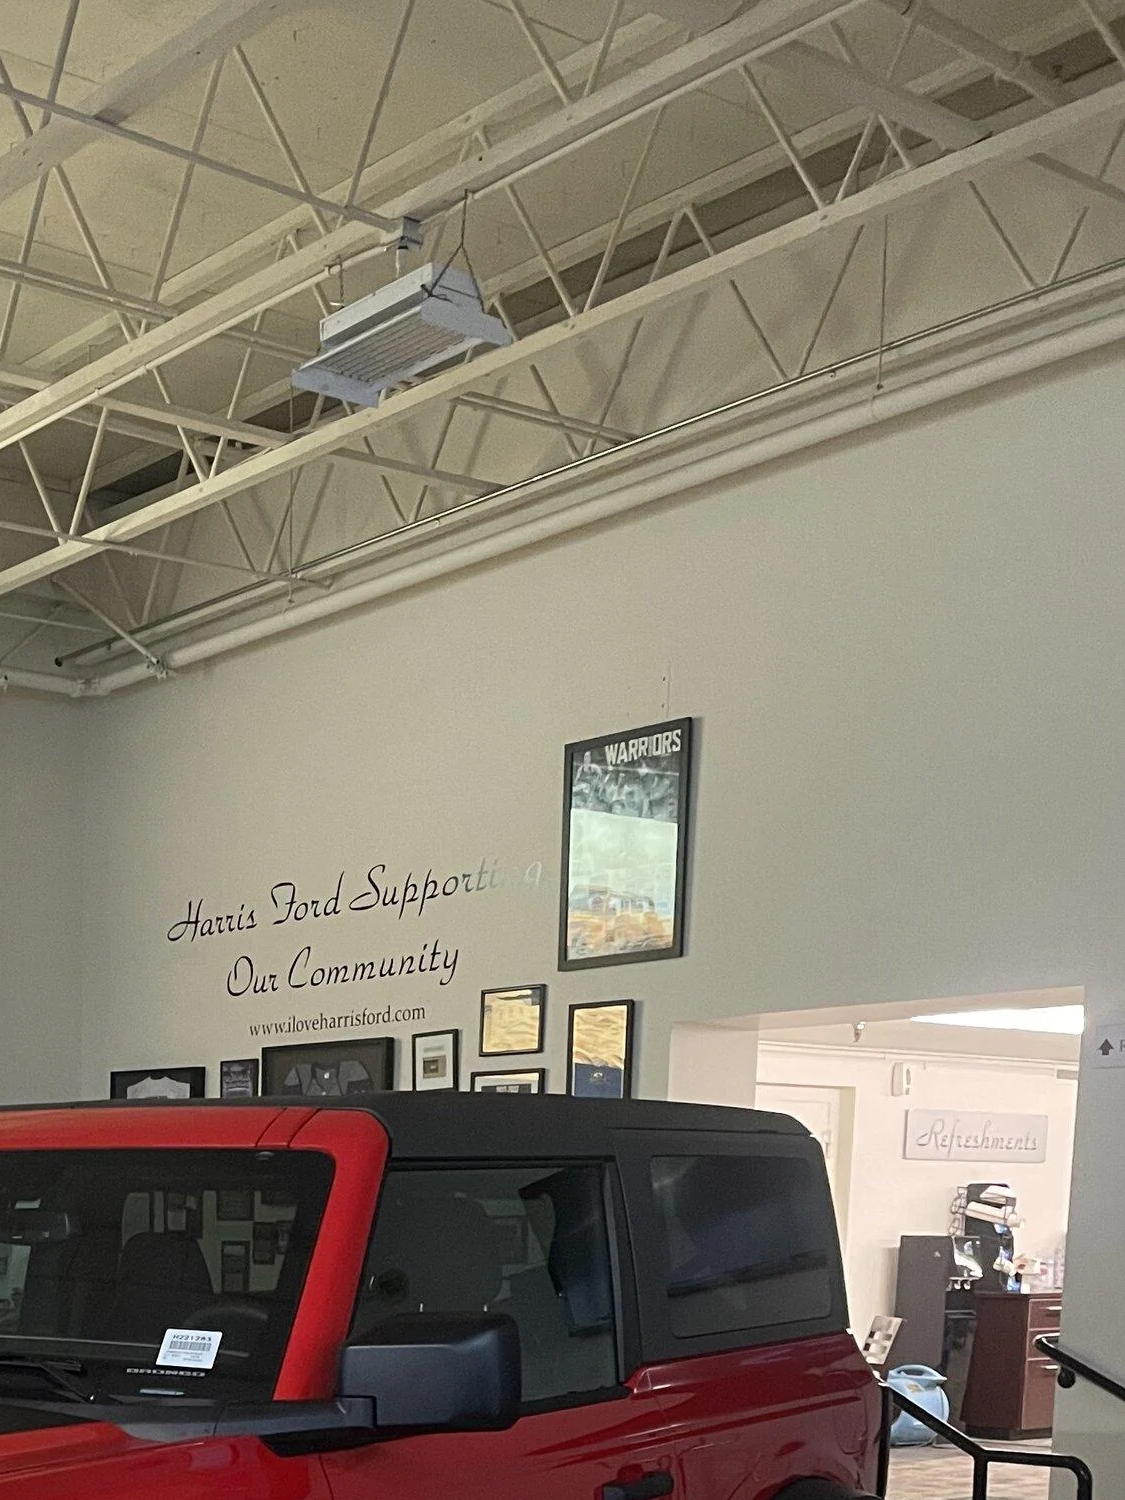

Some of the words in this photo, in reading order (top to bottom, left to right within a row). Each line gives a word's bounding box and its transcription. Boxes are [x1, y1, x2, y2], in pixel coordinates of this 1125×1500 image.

[604, 729, 682, 765] WARRIORS
[167, 898, 258, 942] Harris
[271, 870, 345, 925] Ford
[348, 856, 542, 920] Supportig
[227, 955, 279, 997] Our
[287, 938, 459, 989] Community
[249, 1004, 426, 1036] www.iloveharrisford.com
[916, 1117, 1038, 1159] Refreshments
